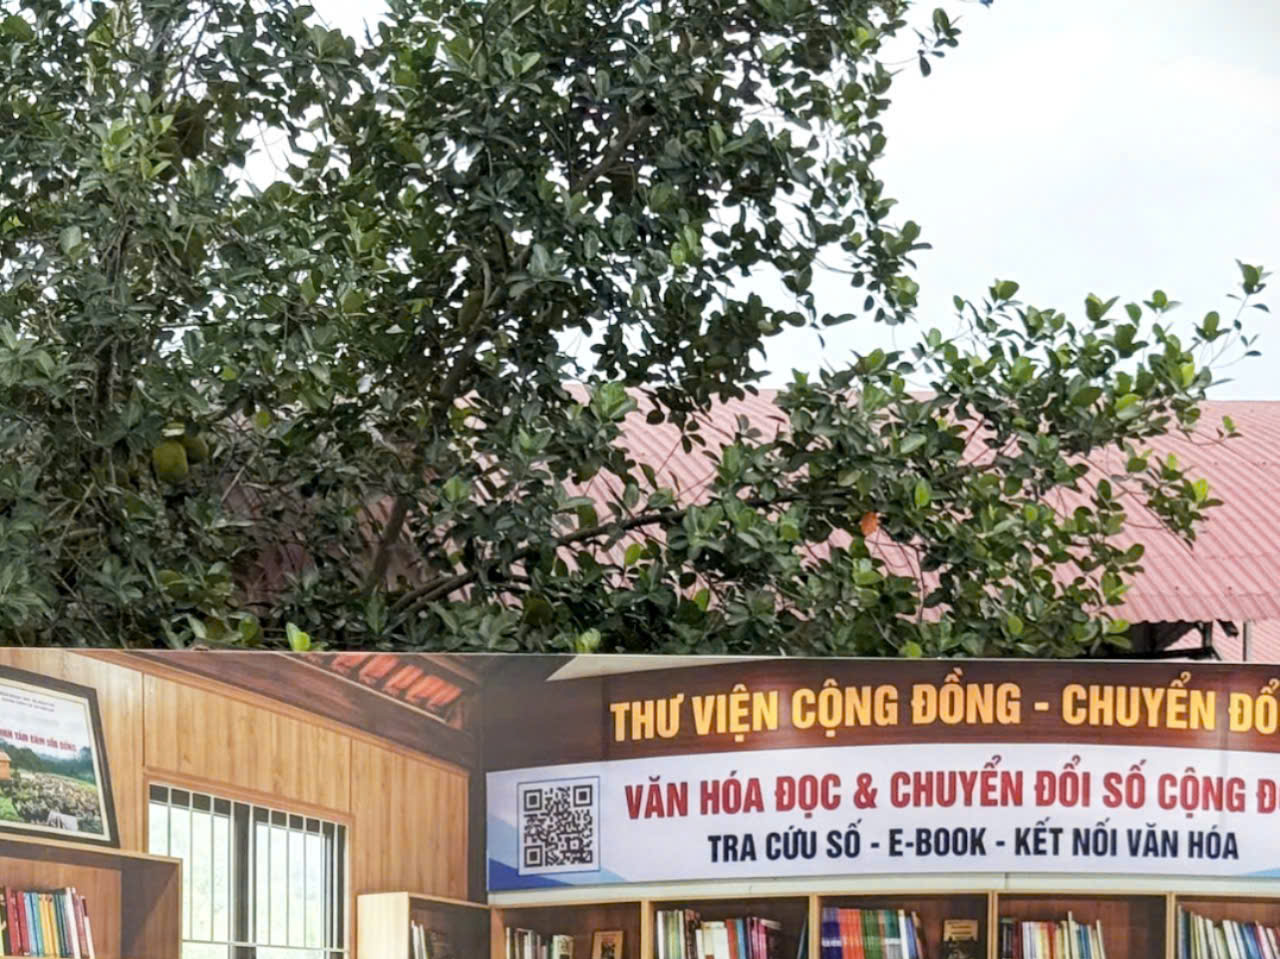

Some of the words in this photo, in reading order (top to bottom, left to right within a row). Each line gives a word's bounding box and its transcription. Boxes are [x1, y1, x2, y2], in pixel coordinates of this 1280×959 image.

[610, 693, 684, 742] THƯ
[692, 684, 778, 742] VIỆN
[792, 678, 898, 737] CỘNG
[911, 667, 1021, 725] ĐỒNG
[1062, 671, 1216, 730] CHUYỂN
[624, 775, 688, 820] VĂN
[700, 770, 765, 815] HÓA
[774, 773, 842, 819] ĐỌC
[853, 773, 878, 810] &
[890, 754, 1024, 808] CHUYỂN
[1034, 754, 1091, 808] ĐỔI
[1102, 759, 1147, 810] SỐ
[1158, 767, 1246, 819] CỘNG
[1256, 778, 1280, 814] Đ
[707, 834, 757, 863] TRA
[765, 825, 817, 861] CỨU
[826, 818, 863, 859] SỐ
[888, 827, 987, 857] E-BOOK
[1014, 816, 1064, 857] KẾT
[1072, 817, 1118, 857] NỐI
[1127, 822, 1179, 858] VĂN
[1188, 824, 1240, 860] HÓA
